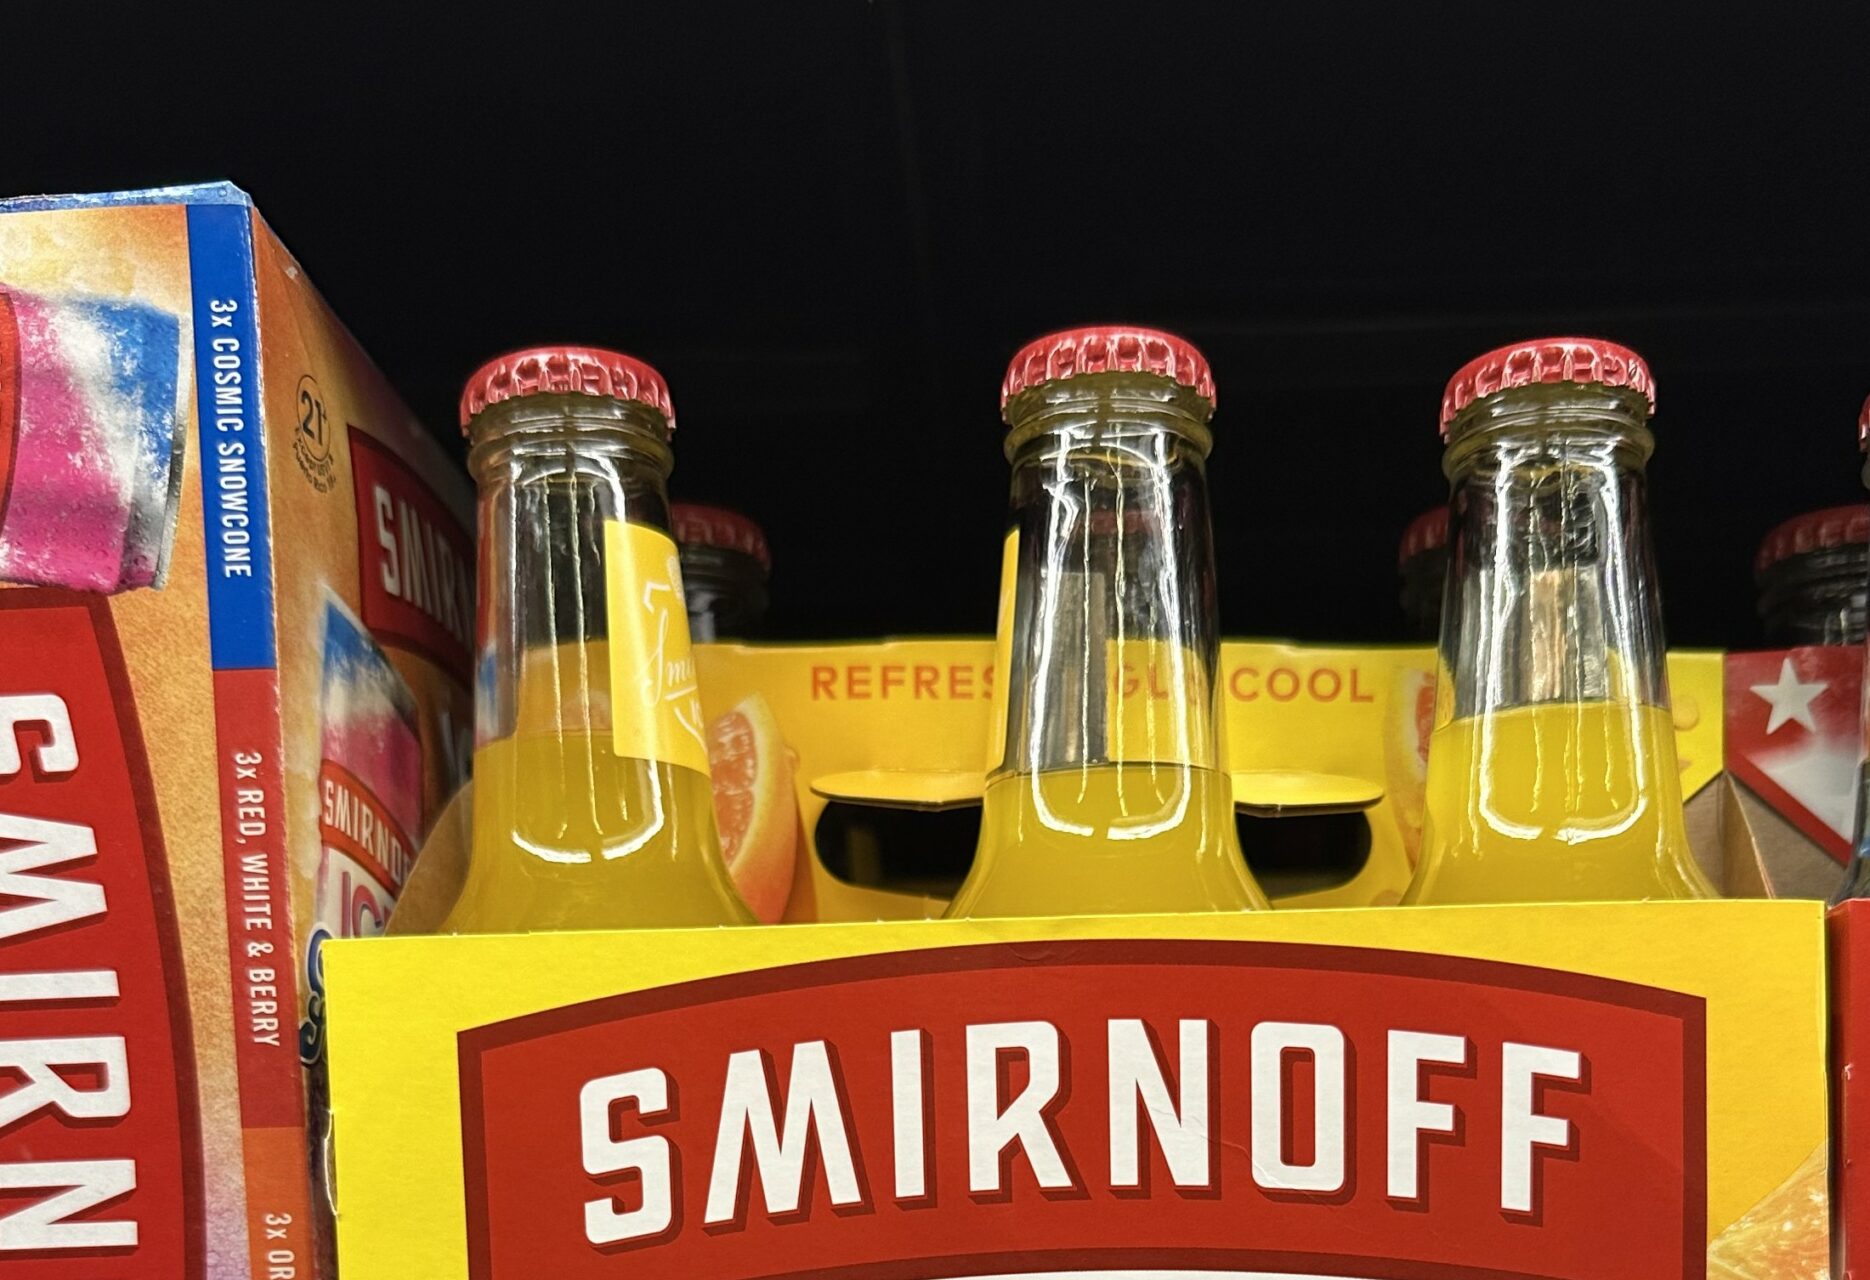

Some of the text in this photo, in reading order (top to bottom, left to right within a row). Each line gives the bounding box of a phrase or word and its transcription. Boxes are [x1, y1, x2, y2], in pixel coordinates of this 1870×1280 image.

[210, 300, 252, 579] 3x COSMIC SNOWCONE
[1230, 667, 1374, 703] COOL
[234, 752, 280, 1048] 3x RED, WHITE & BERRY
[265, 1212, 292, 1241] 3x
[579, 1018, 1590, 1250] SMIRNOFF
